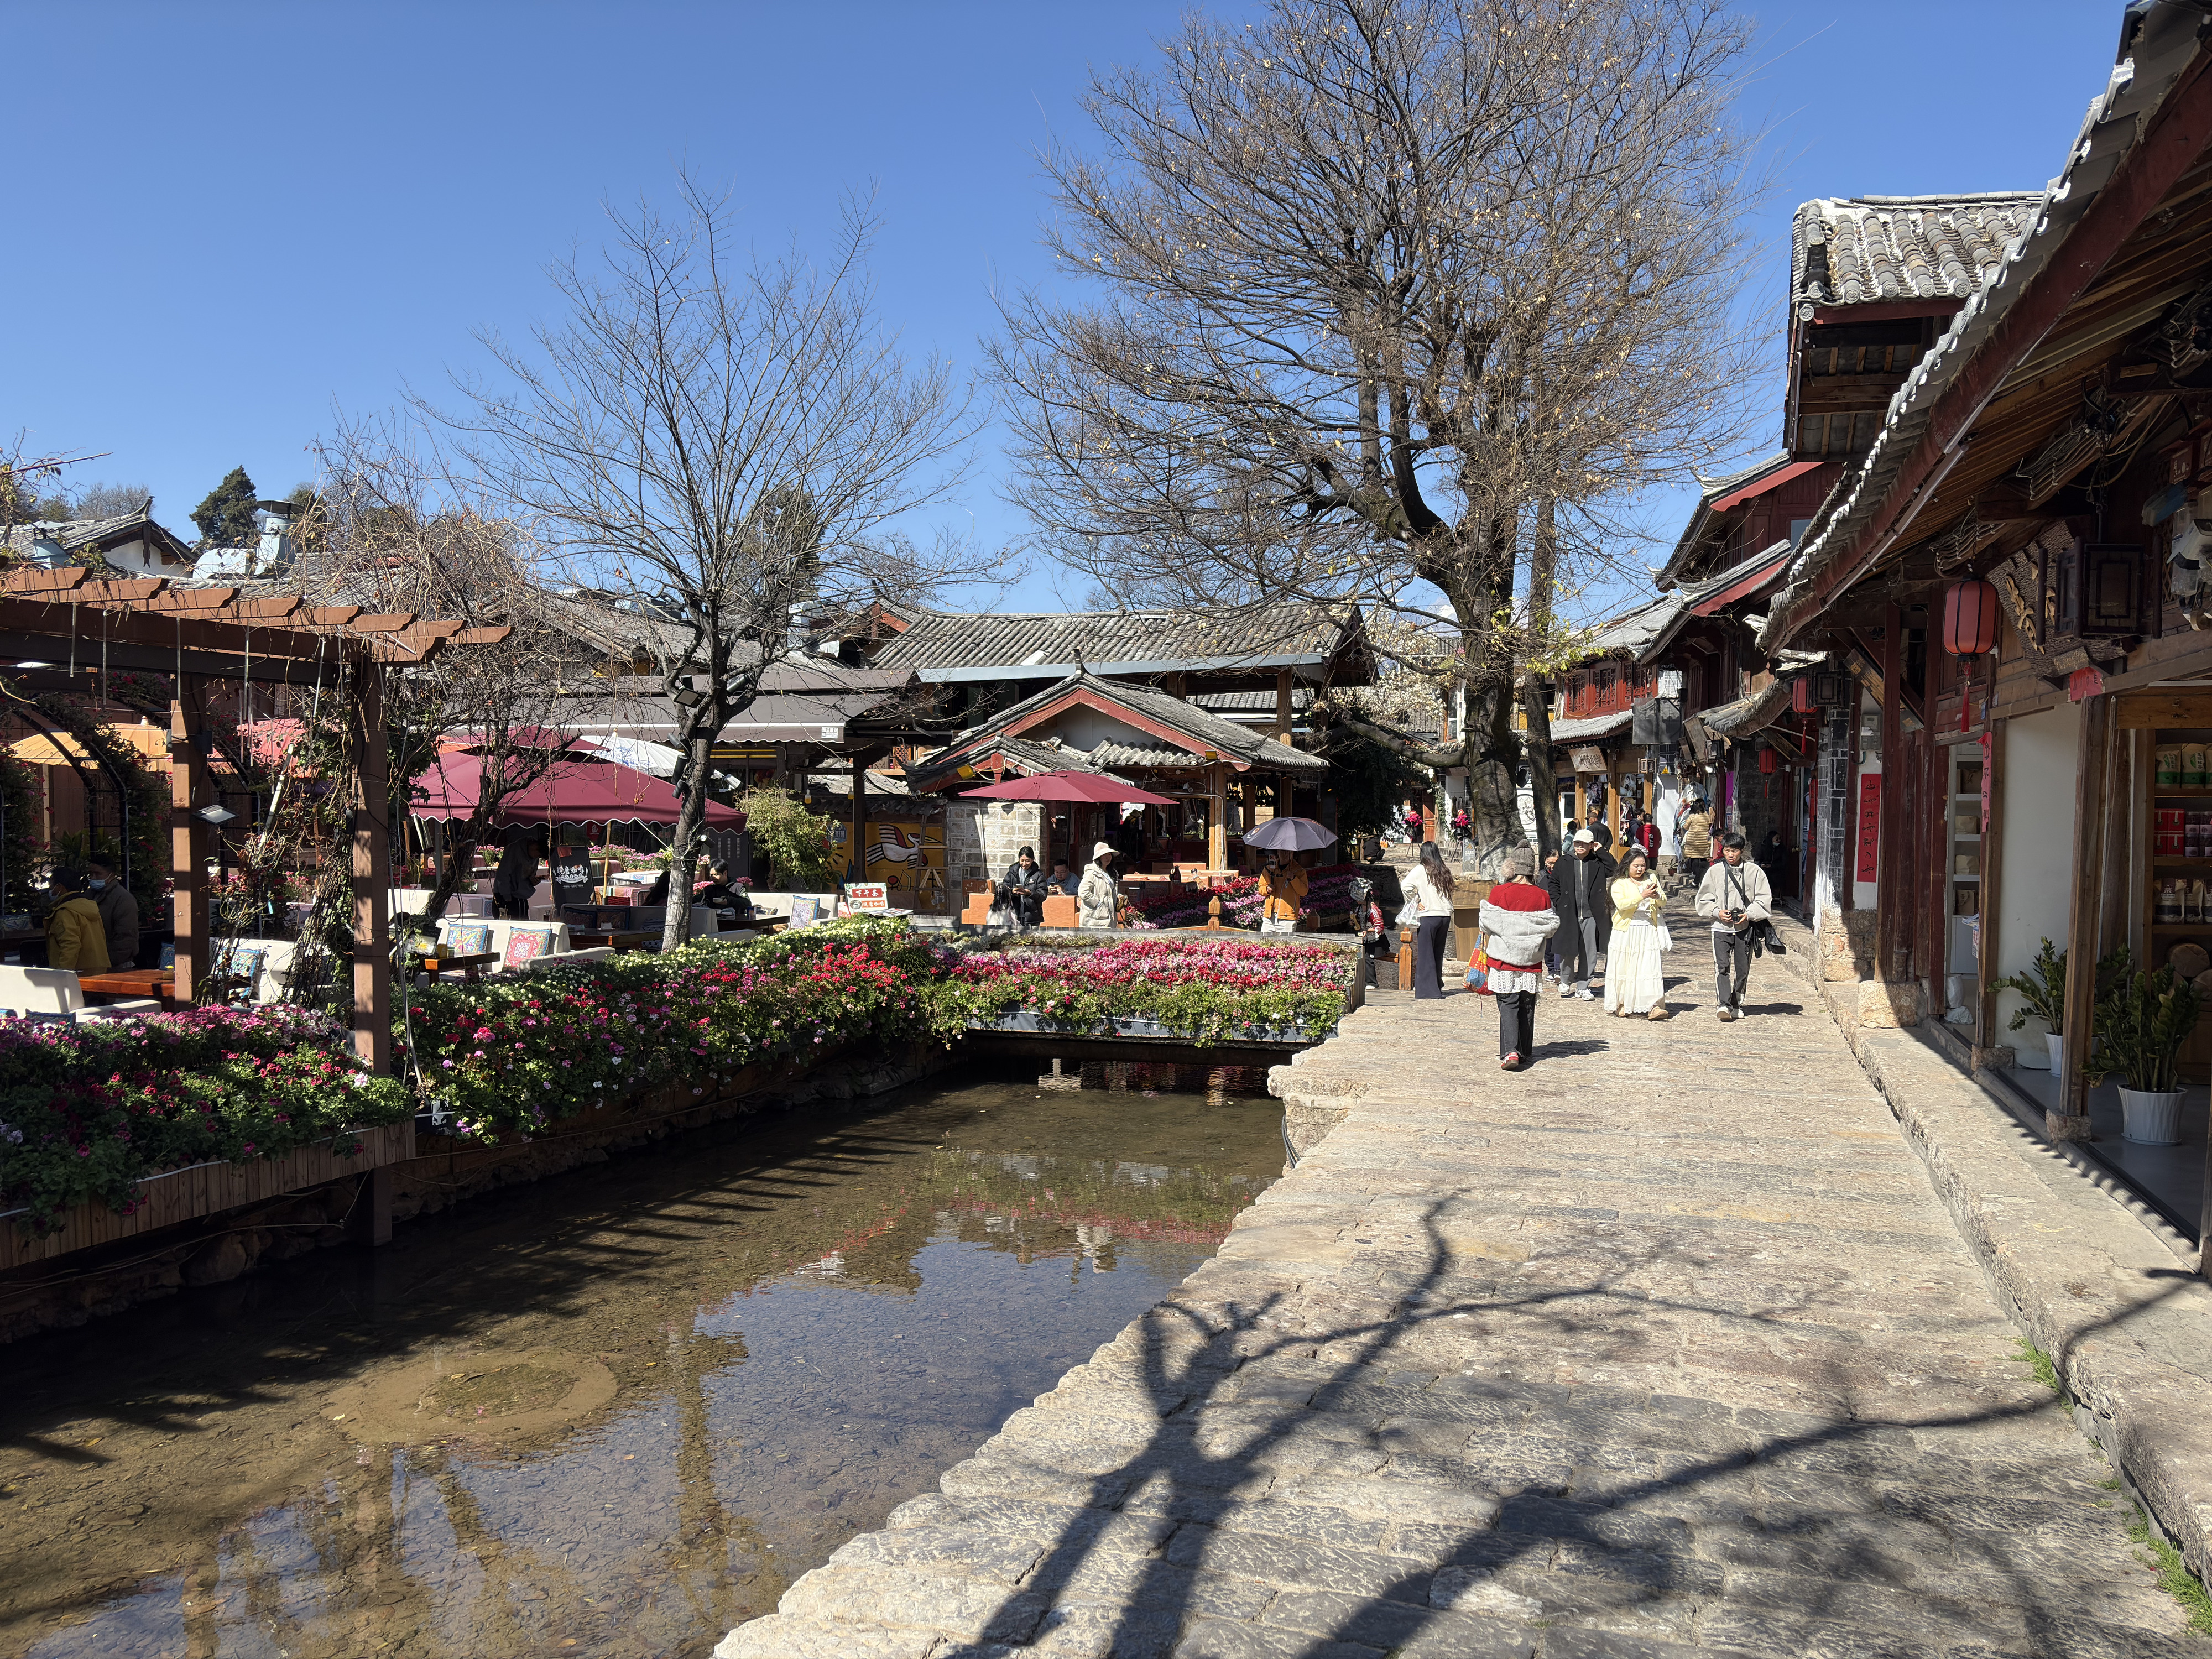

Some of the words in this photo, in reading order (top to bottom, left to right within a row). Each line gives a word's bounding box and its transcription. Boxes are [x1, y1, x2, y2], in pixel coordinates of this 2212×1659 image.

[855, 889, 879, 897] 下午茶
[2163, 885, 2172, 893] 茶
